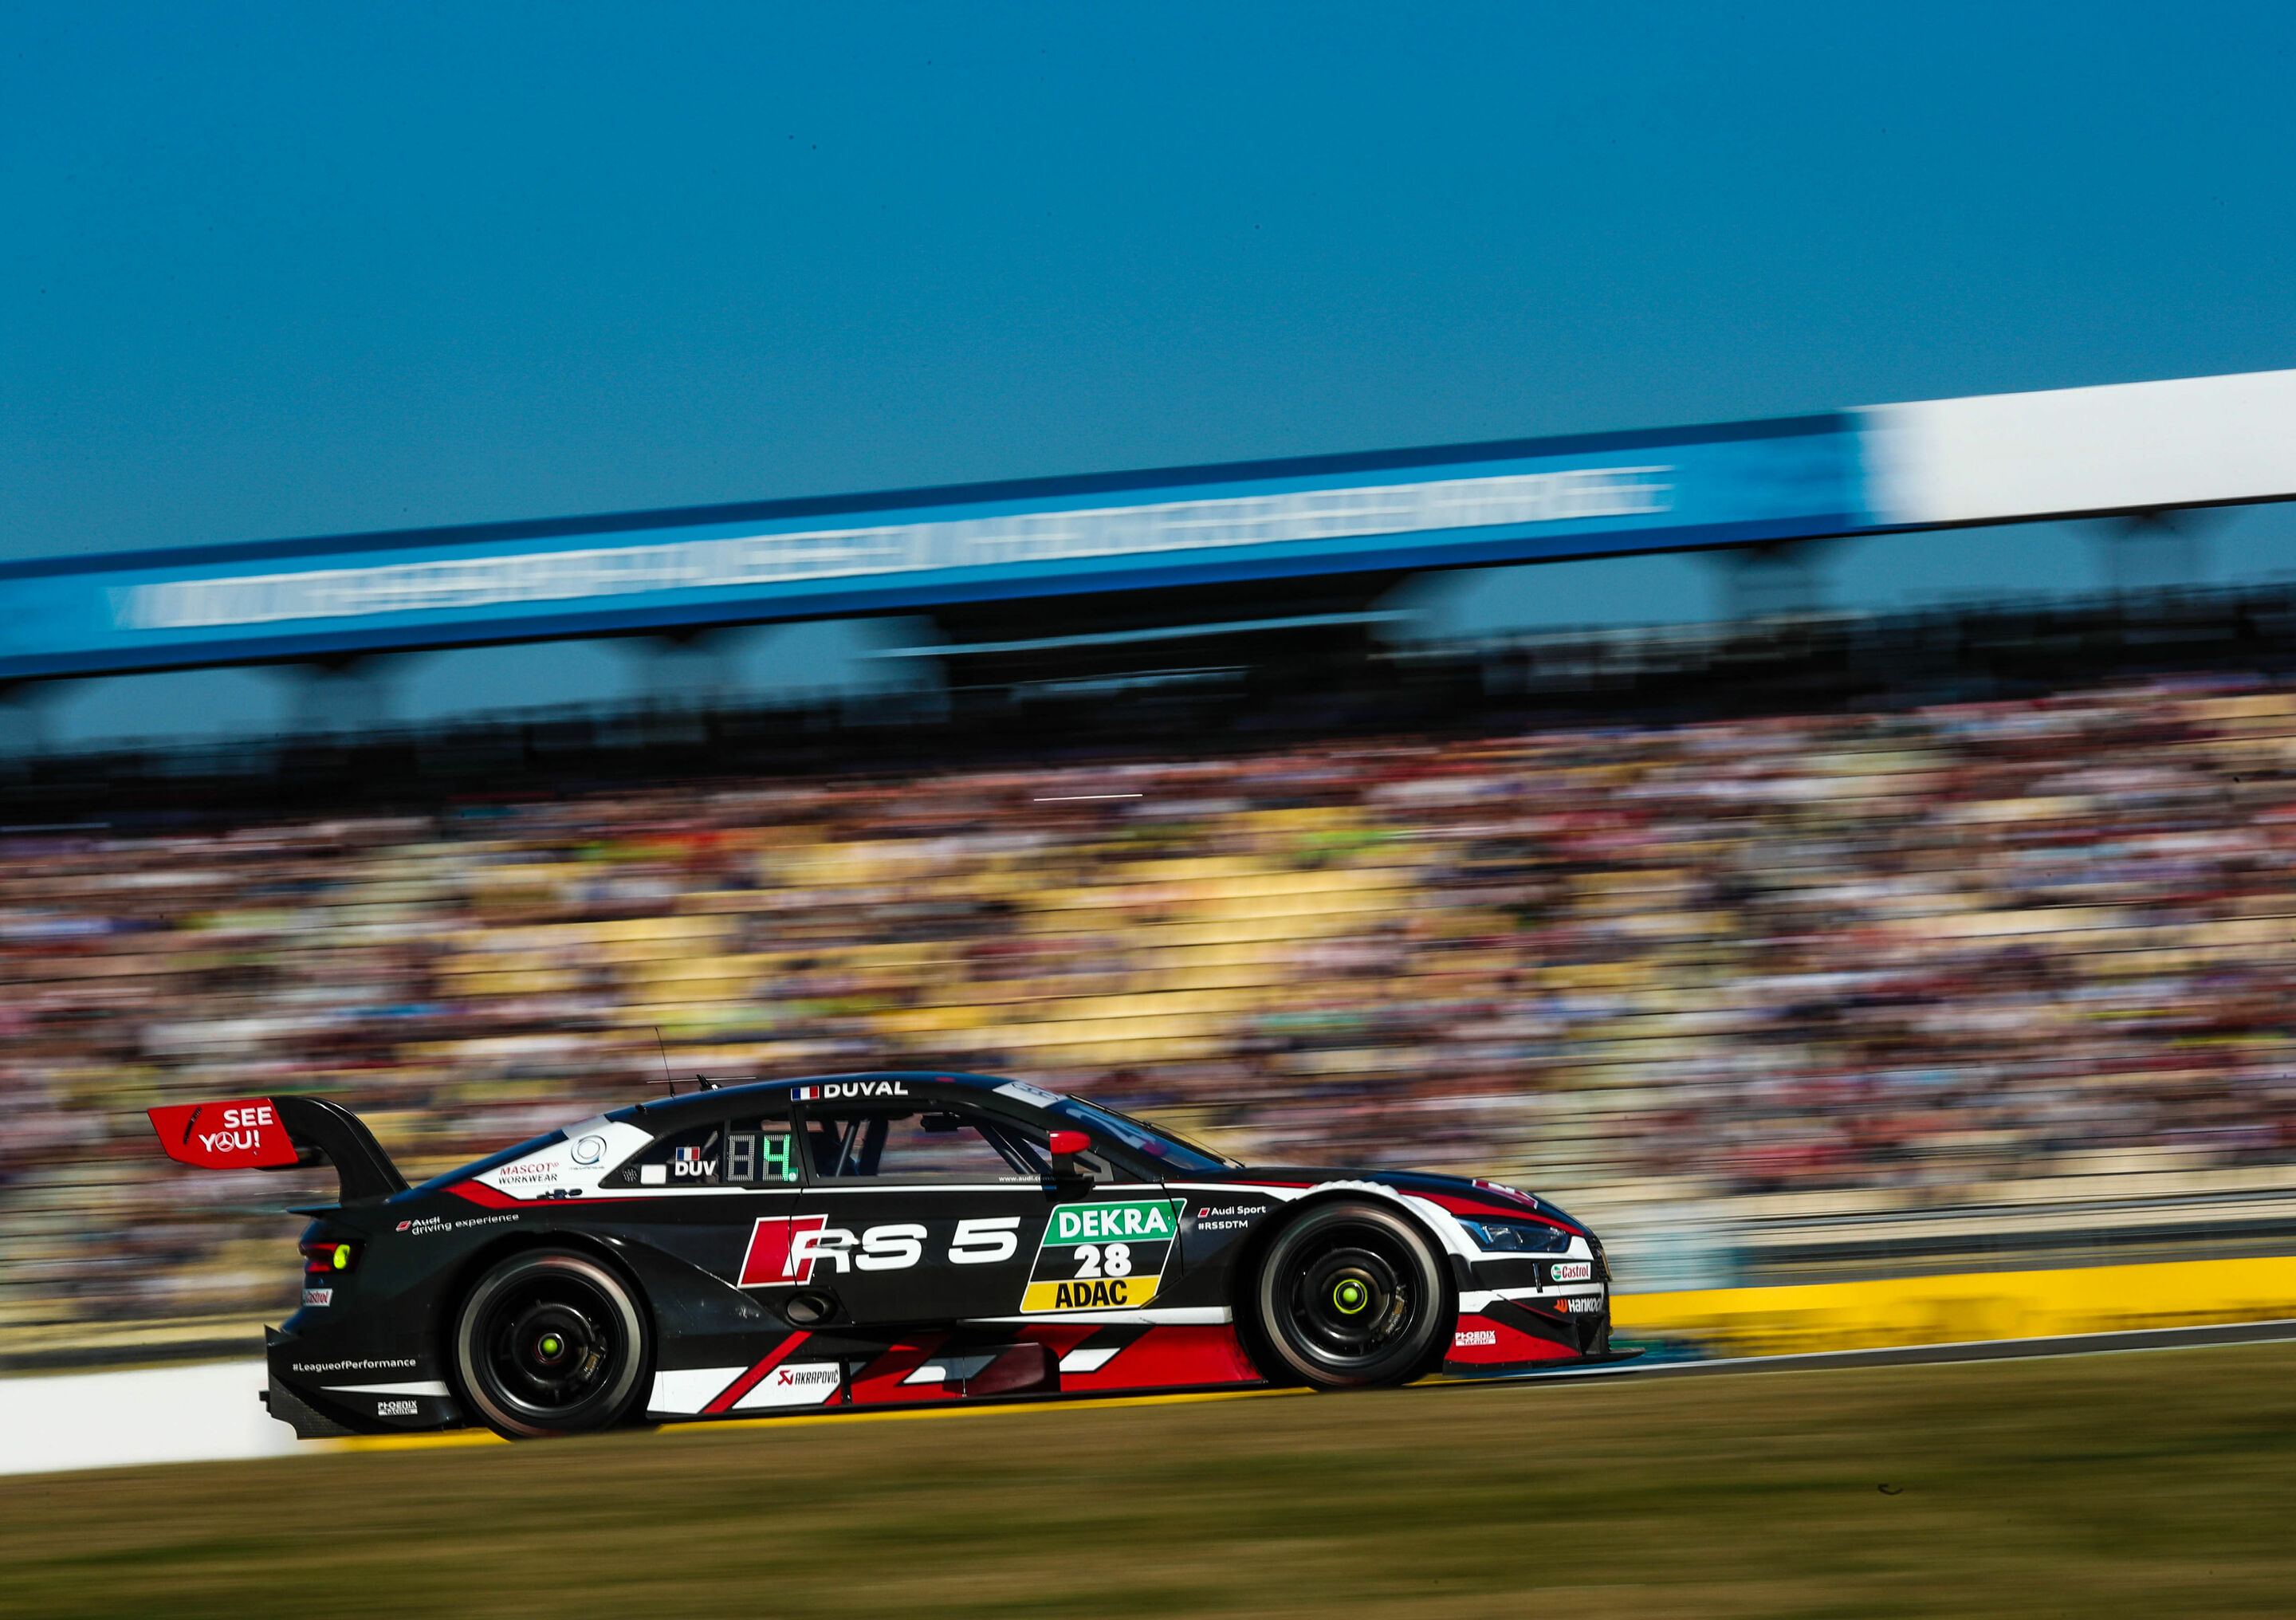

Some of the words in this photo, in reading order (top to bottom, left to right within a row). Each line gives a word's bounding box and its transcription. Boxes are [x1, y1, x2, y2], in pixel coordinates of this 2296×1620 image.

[824, 1080, 909, 1099] DUVAL
[223, 1106, 273, 1129] SEE
[674, 1161, 717, 1177] DUV
[498, 1173, 558, 1186] WORKWEAR
[1211, 1205, 1234, 1216] Audi
[1236, 1205, 1267, 1216] Sport
[411, 1216, 441, 1228] Audi
[411, 1221, 452, 1236] driving
[455, 1213, 520, 1229] experience
[1059, 1207, 1169, 1239] DEKRA
[1197, 1220, 1248, 1230] #RS5DTM
[781, 1223, 928, 1277] RS
[948, 1216, 1021, 1264] 5
[1073, 1242, 1132, 1279] 28
[1562, 1264, 1589, 1279] Castrol
[1055, 1280, 1128, 1309] ADAC
[1567, 1297, 1602, 1313] Hankoo
[292, 1359, 416, 1373] #LeagueofPerformance
